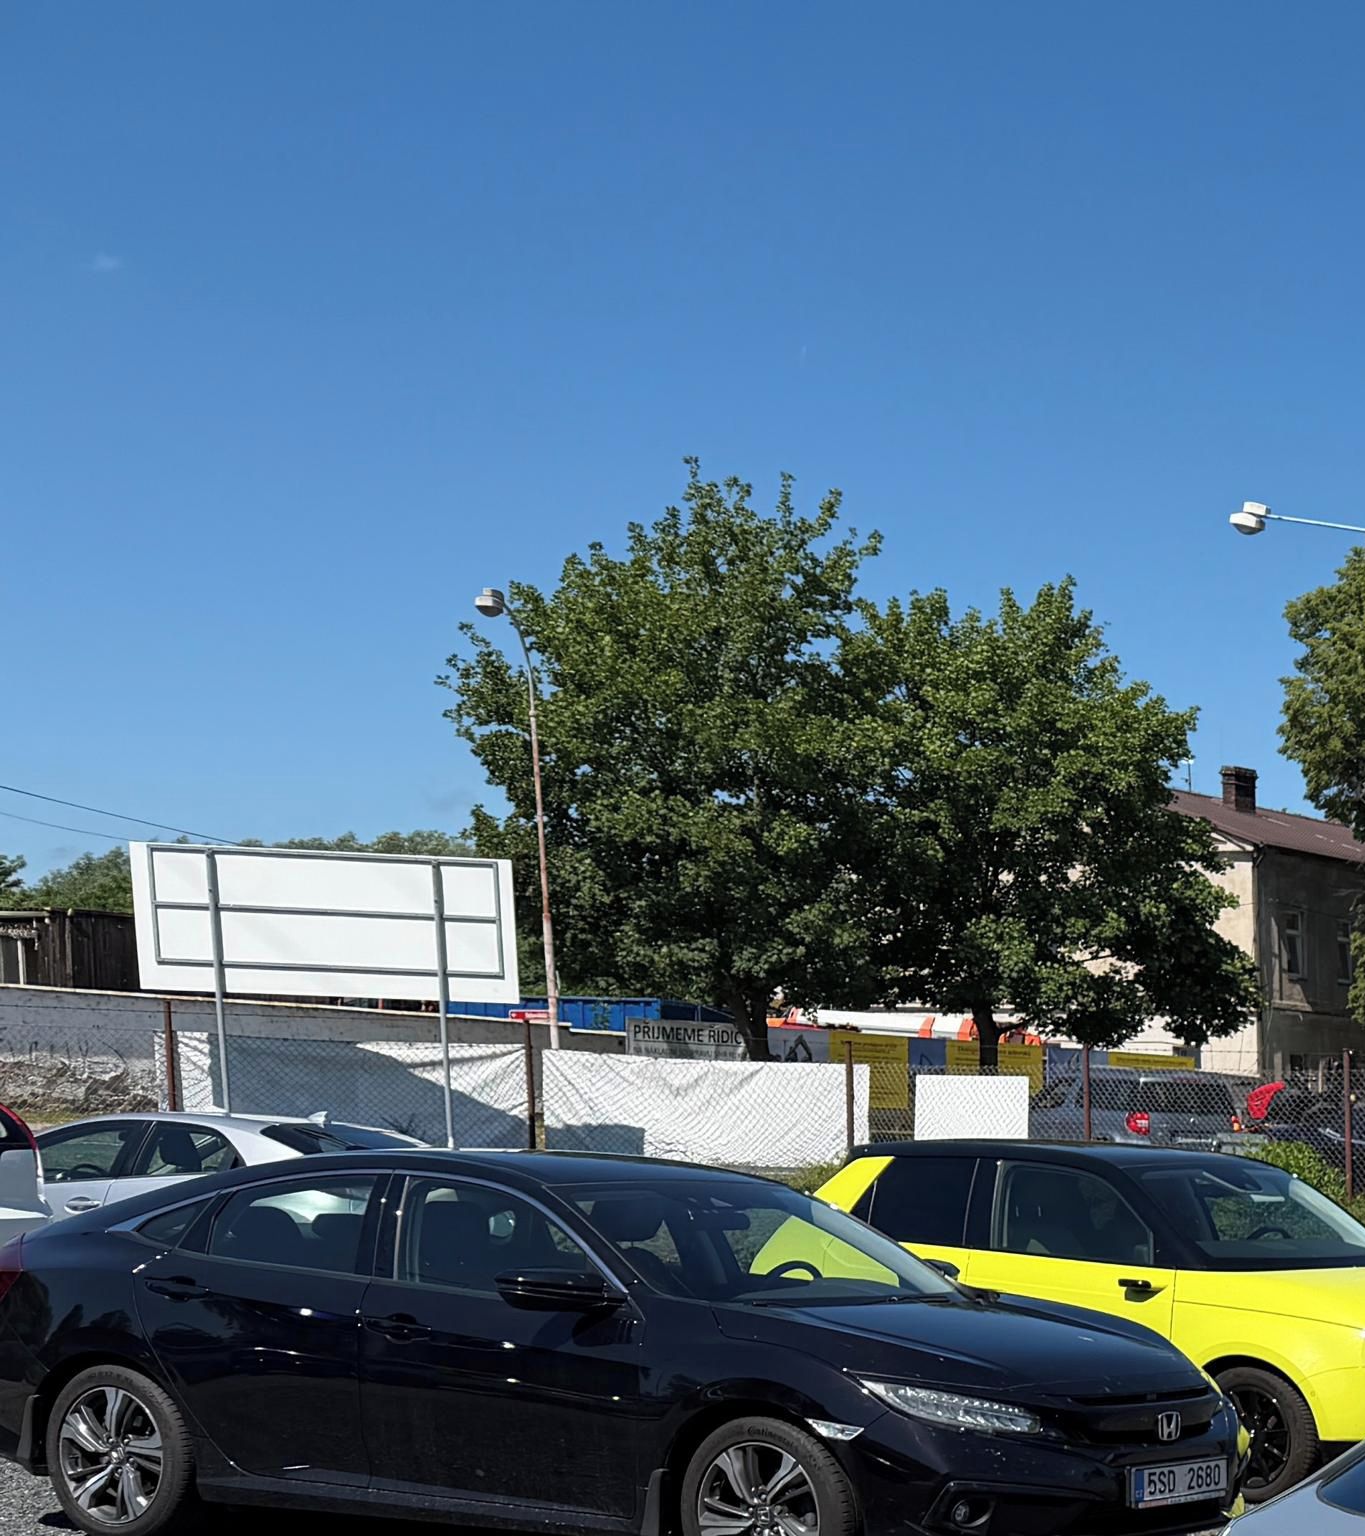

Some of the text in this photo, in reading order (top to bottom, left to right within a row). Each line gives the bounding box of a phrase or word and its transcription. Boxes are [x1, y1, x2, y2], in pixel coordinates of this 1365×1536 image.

[633, 1020, 705, 1043] PŘIJMEME
[1148, 1463, 1221, 1496] 5SD 2680
